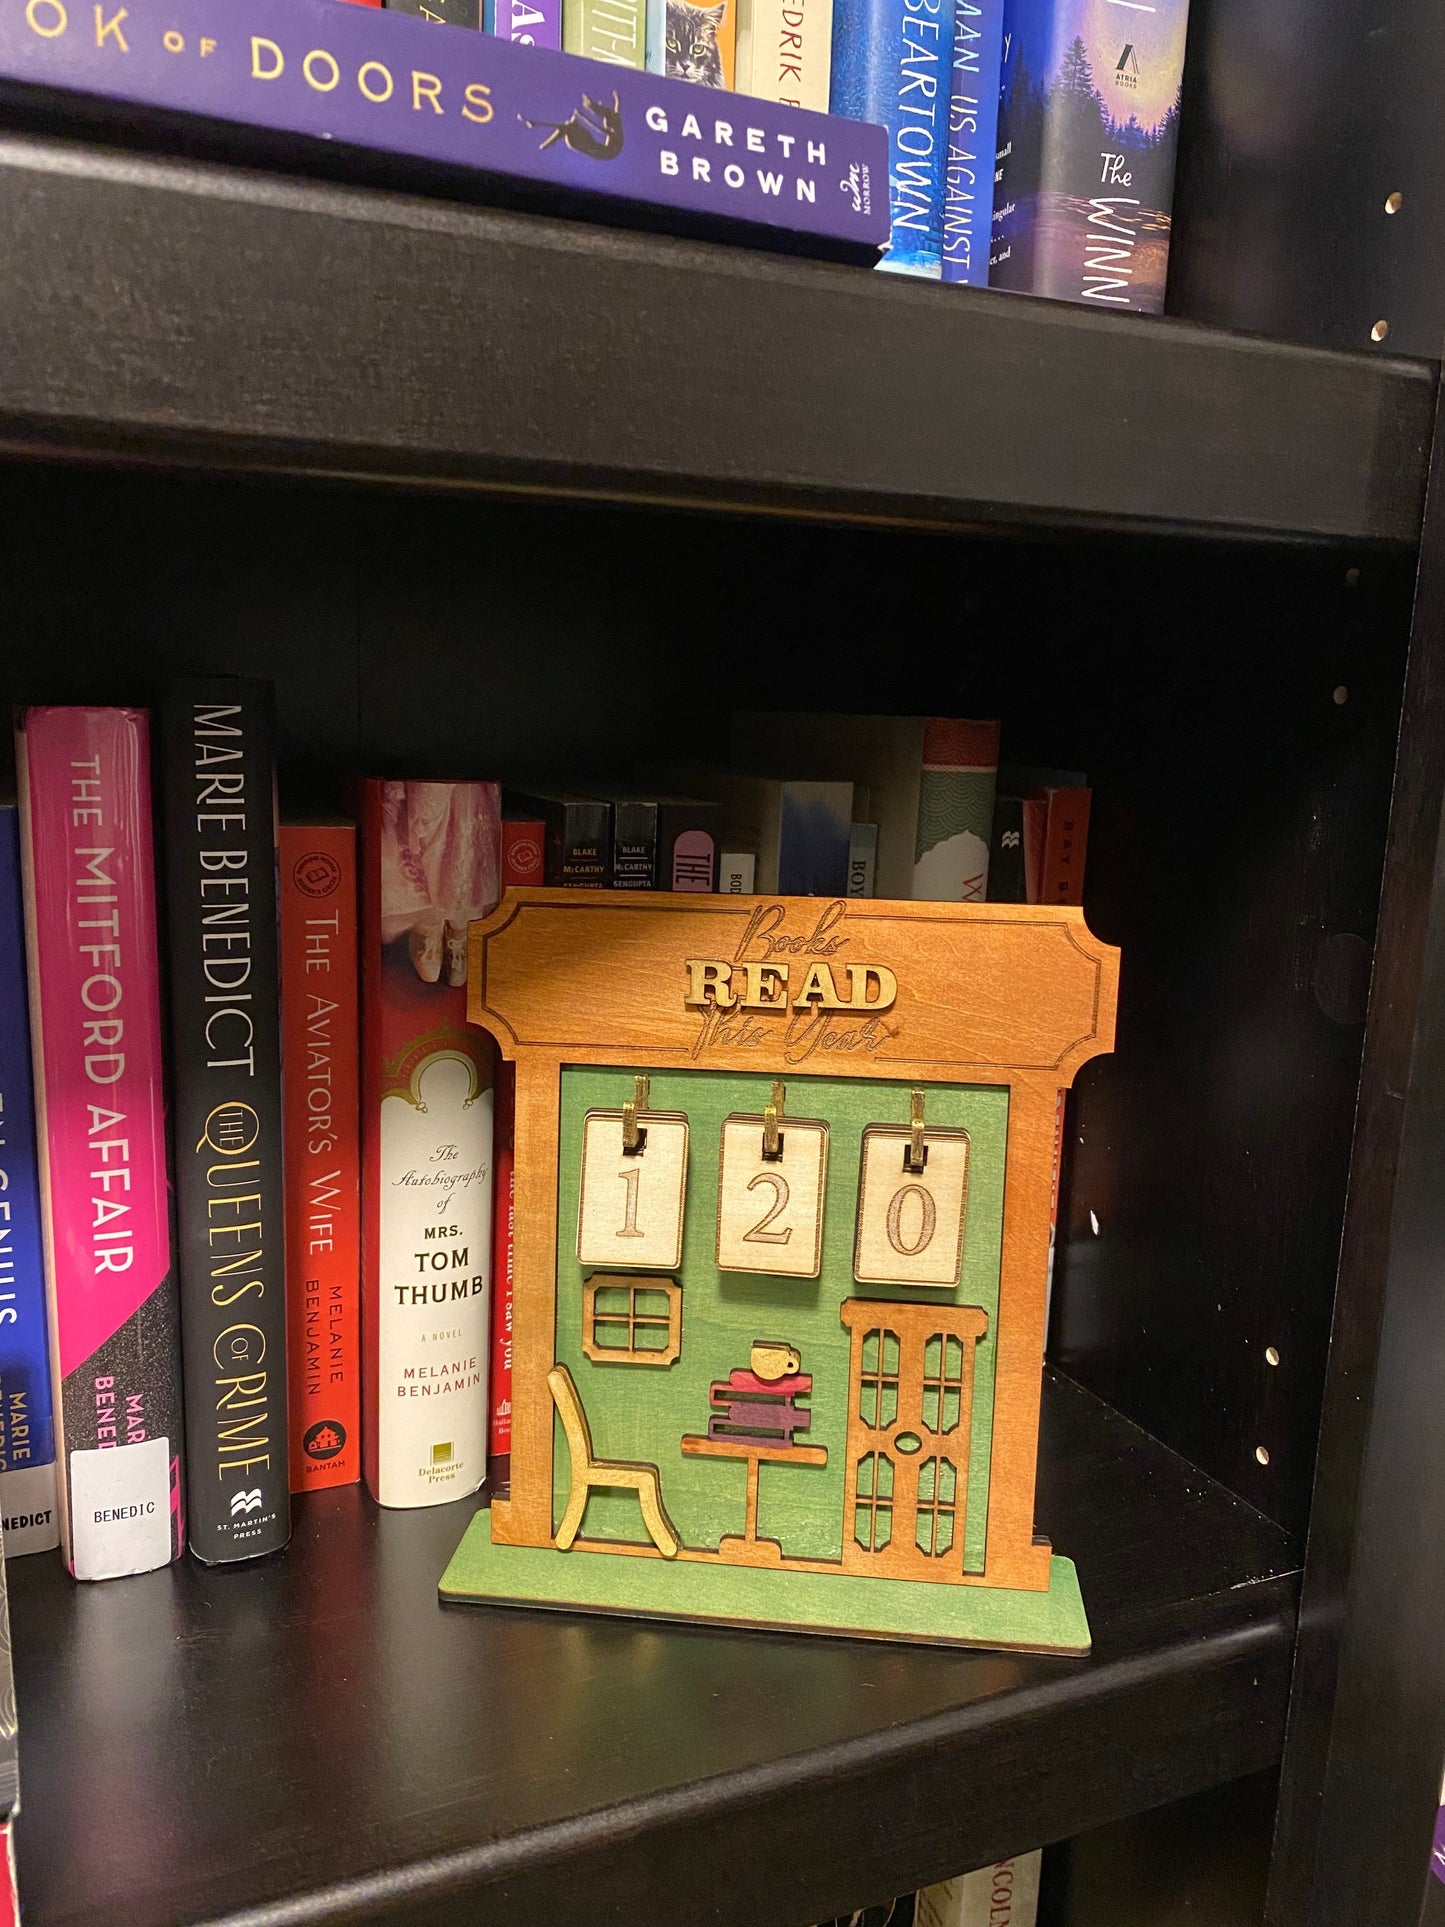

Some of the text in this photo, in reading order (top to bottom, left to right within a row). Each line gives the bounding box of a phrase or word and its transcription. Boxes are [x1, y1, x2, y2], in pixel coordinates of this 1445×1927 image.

[163, 30, 217, 58] OF
[250, 36, 493, 124] DOORS
[1115, 73, 1137, 83] ATRIA
[1115, 81, 1137, 89] BOOKS
[645, 106, 827, 166] GARETH
[660, 150, 817, 203] BROWN
[1100, 152, 1132, 187] The
[861, 163, 871, 216] MORROW
[943, 144, 977, 270] AGAINST
[1081, 197, 1140, 303] WINN
[572, 848, 597, 856] BLAKE
[622, 846, 646, 854] BLAKE
[613, 880, 652, 888] SENGUPTA
[675, 853, 711, 887] THE
[193, 704, 255, 1077] MARIE BENEDICT
[304, 909, 339, 974] THE
[733, 900, 850, 962] Books
[684, 958, 899, 1011] READ
[70, 754, 135, 1276] THE MITFORD AFFAIR
[691, 1001, 890, 1065] This Year
[306, 994, 340, 1155] AVIATOR'S
[429, 1144, 459, 1162] The
[391, 1162, 489, 1191] Autobiography
[196, 1101, 265, 1306] THE QUEENS
[308, 1170, 343, 1256] WIFE
[436, 1192, 456, 1214] of
[615, 1167, 645, 1239] 1
[742, 1171, 794, 1246] 2
[424, 1224, 463, 1240] MRS.
[414, 1246, 470, 1273] TOM
[394, 1275, 483, 1305] THUMB
[305, 1279, 321, 1396] BENJAMIN
[329, 1285, 344, 1384] MELANIE
[421, 1329, 462, 1343] A NOVEL
[397, 1372, 481, 1397] BENJAMIN
[403, 1356, 477, 1379] MELANIE
[213, 1323, 270, 1481] OF CRIME
[9, 1391, 31, 1461] MARIE
[305, 1460, 346, 1474] BANTAM
[418, 1461, 464, 1477] Delacorte
[428, 1473, 456, 1484] Press
[94, 1501, 155, 1523] BENEDIC
[233, 1513, 276, 1529] MARTIN'S
[233, 1528, 262, 1540] PRESS
